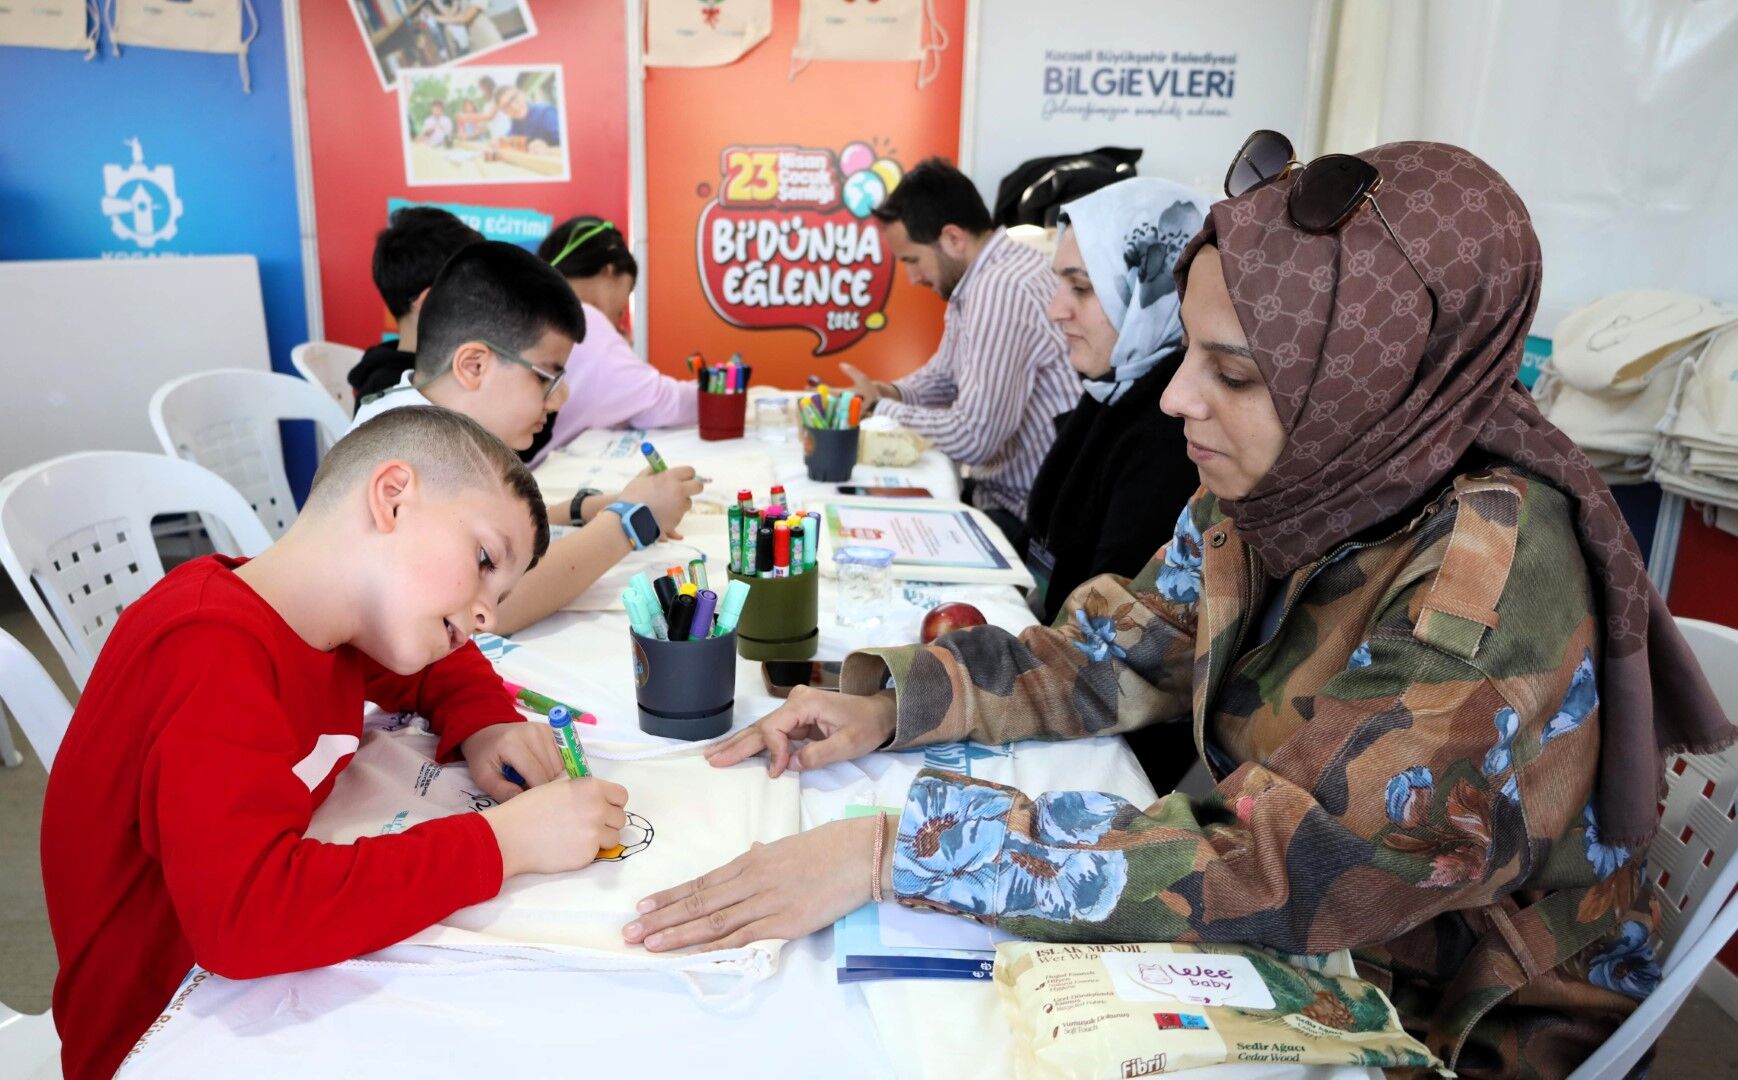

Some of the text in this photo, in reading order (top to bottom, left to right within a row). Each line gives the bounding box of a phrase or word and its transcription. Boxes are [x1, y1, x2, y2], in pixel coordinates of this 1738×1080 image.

[727, 153, 778, 201] 23
[723, 260, 873, 308] EĞLENCE
[826, 311, 860, 331] 2026
[1168, 963, 1233, 979] Wee
[1189, 977, 1231, 991] baby
[1236, 1042, 1269, 1051] Sedir
[1120, 1052, 1167, 1080] Fibril
[1238, 1052, 1301, 1063] Cedar Wood
